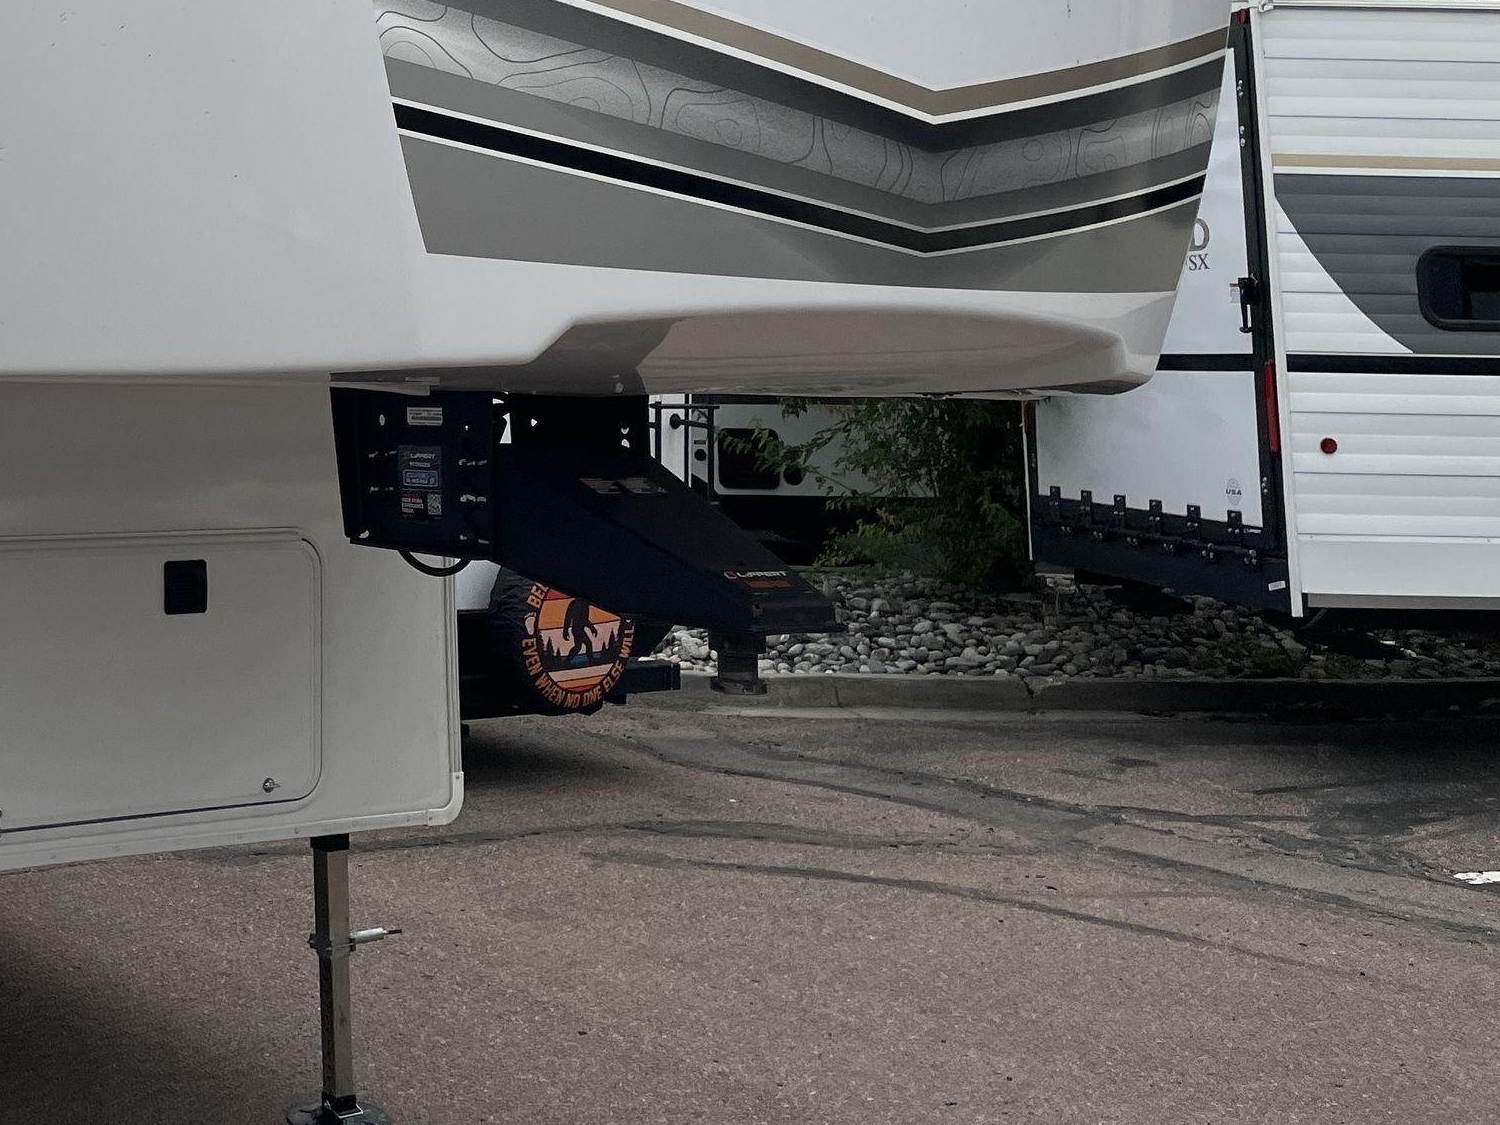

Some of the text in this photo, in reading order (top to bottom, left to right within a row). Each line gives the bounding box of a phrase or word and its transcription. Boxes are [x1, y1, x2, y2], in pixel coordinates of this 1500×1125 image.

[1188, 218, 1210, 251] D
[1186, 253, 1211, 271] SX
[1225, 488, 1242, 496] USA
[526, 582, 549, 609] BEL
[522, 625, 635, 708] EVEN WHEN NO ONE ELSE WILL
